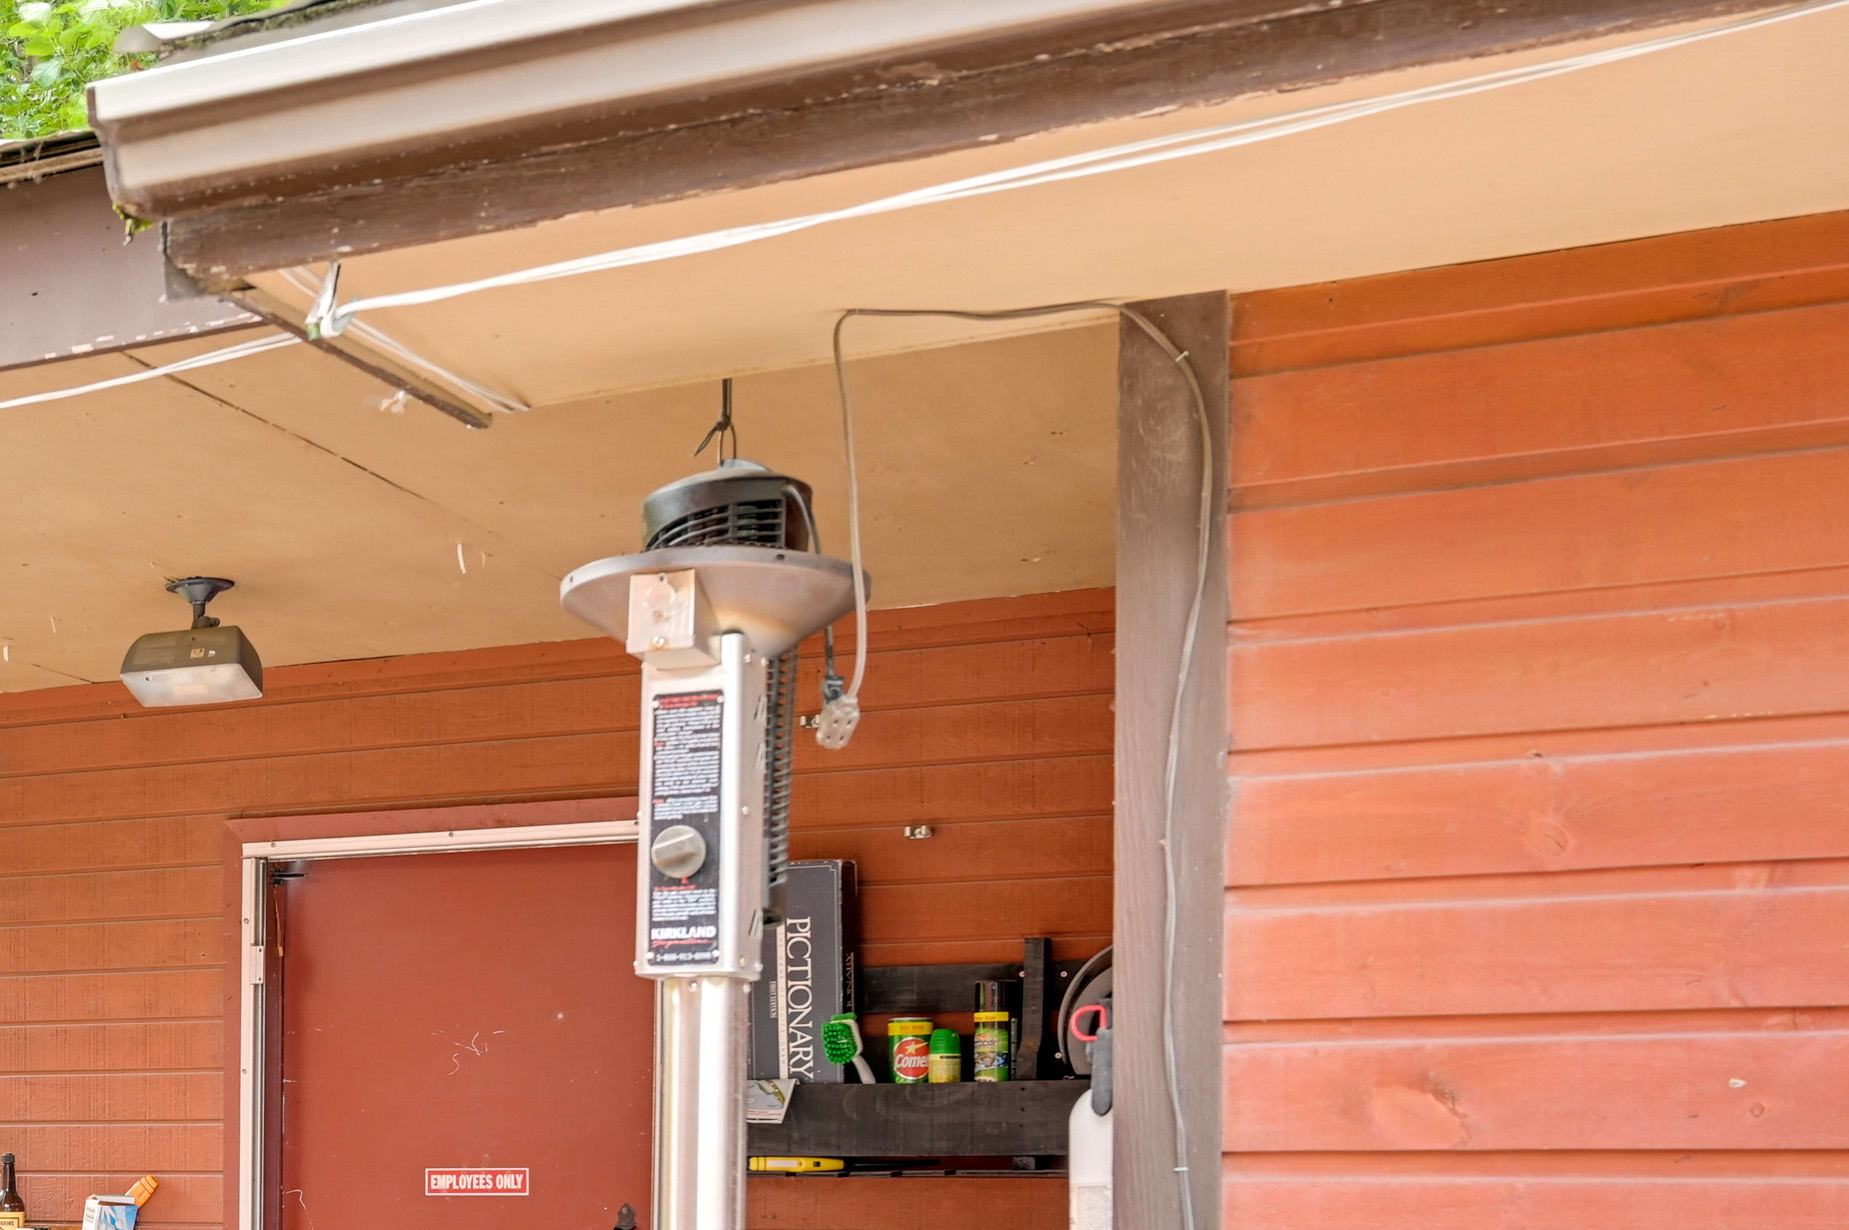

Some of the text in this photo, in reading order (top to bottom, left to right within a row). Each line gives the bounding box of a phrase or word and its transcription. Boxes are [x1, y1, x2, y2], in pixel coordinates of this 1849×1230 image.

[650, 926, 716, 940] KIRKLAND
[786, 916, 814, 1080] PICTIONARY
[895, 1054, 928, 1068] Come
[430, 1174, 524, 1190] EMPLOYEES ONLY
